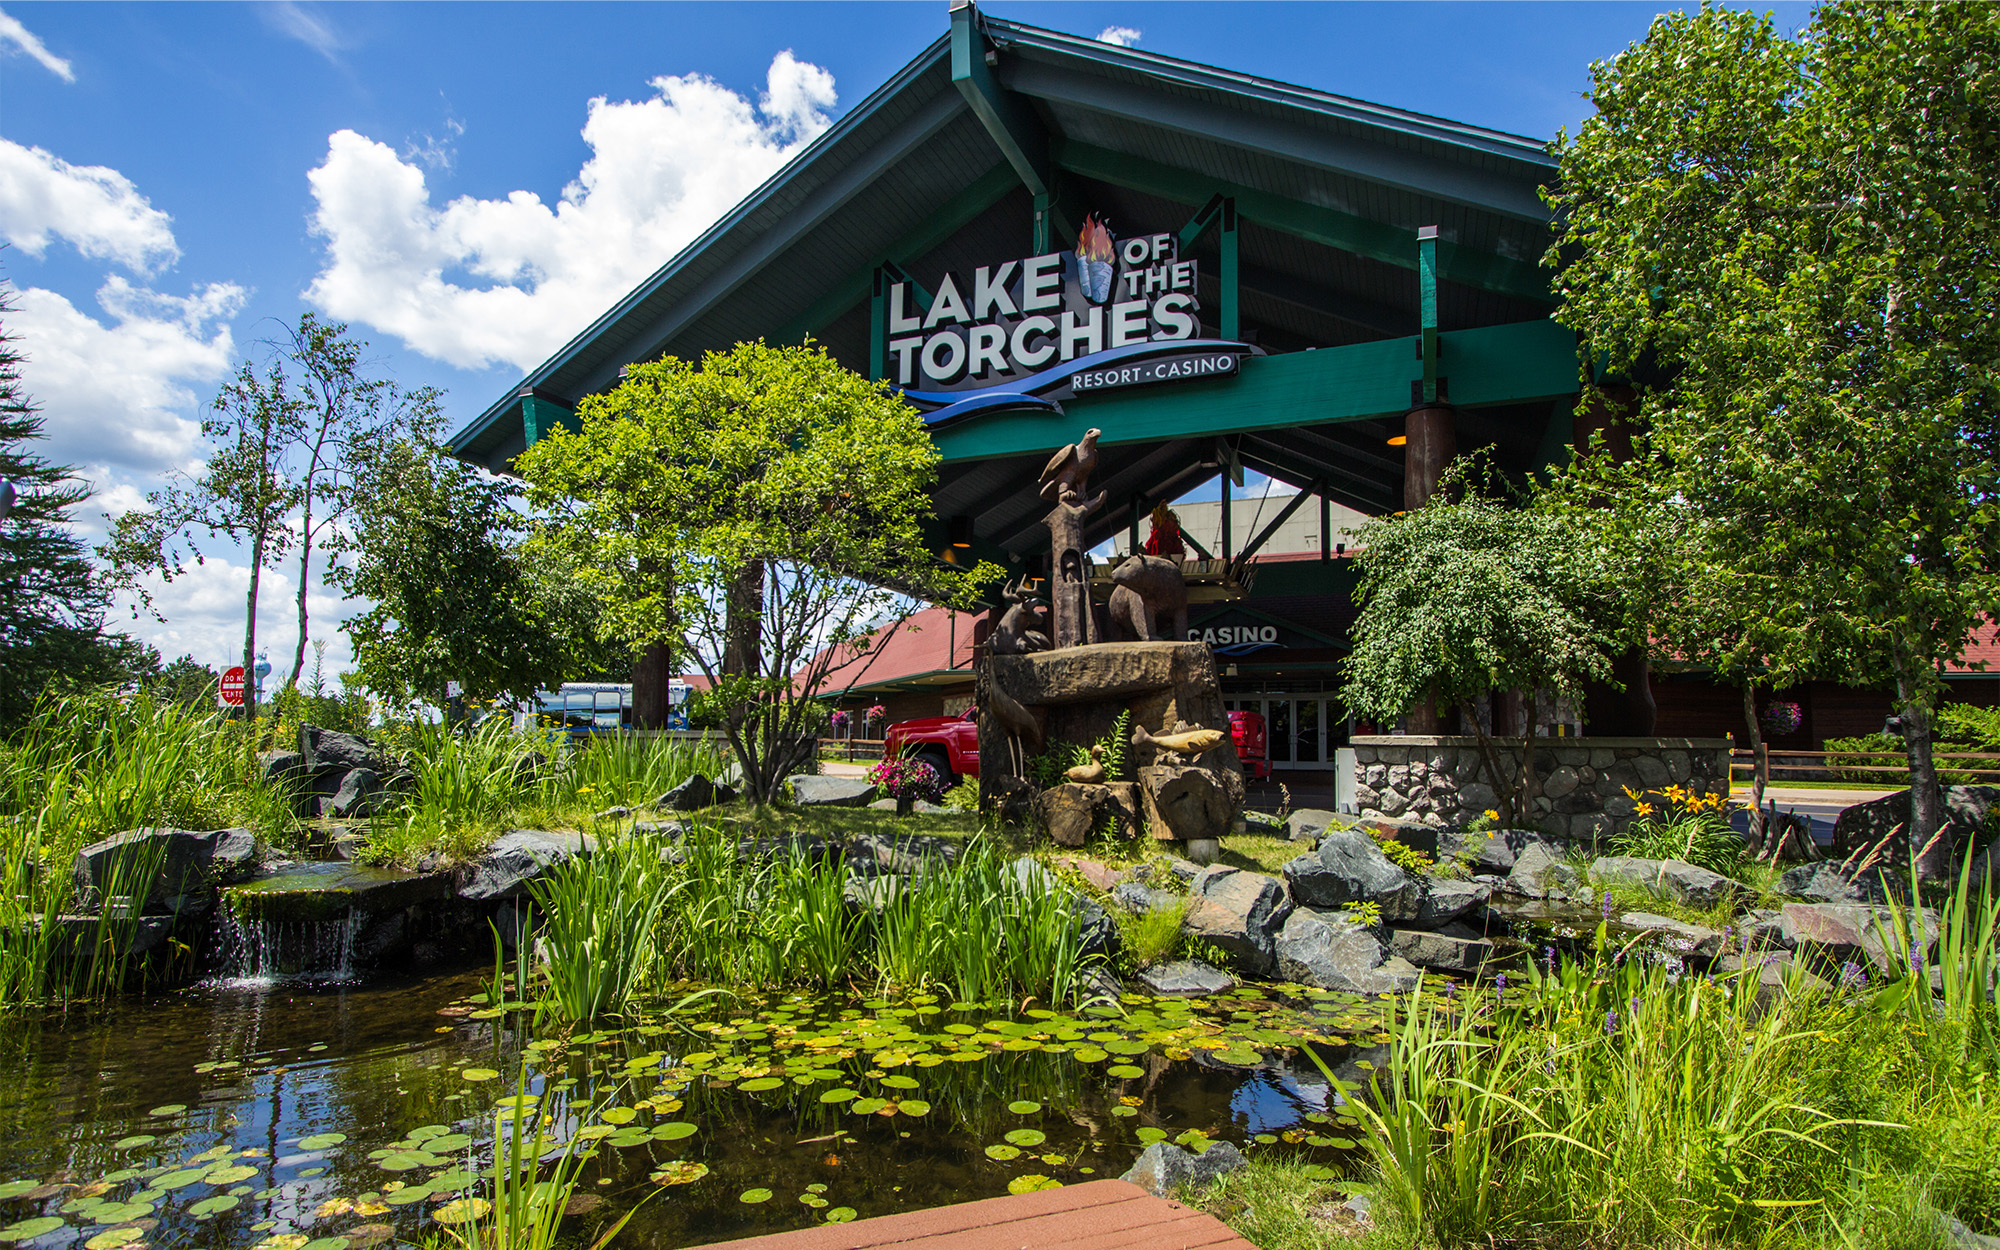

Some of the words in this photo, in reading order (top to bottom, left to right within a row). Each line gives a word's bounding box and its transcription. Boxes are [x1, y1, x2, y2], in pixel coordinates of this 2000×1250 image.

[1123, 232, 1171, 265] OF
[889, 252, 1060, 334] LAKE
[1123, 260, 1191, 296] THE
[889, 292, 1194, 385] TORCHES
[1072, 366, 1140, 390] RESORT
[1154, 355, 1232, 378] CASINO
[1187, 625, 1278, 645] CASINO
